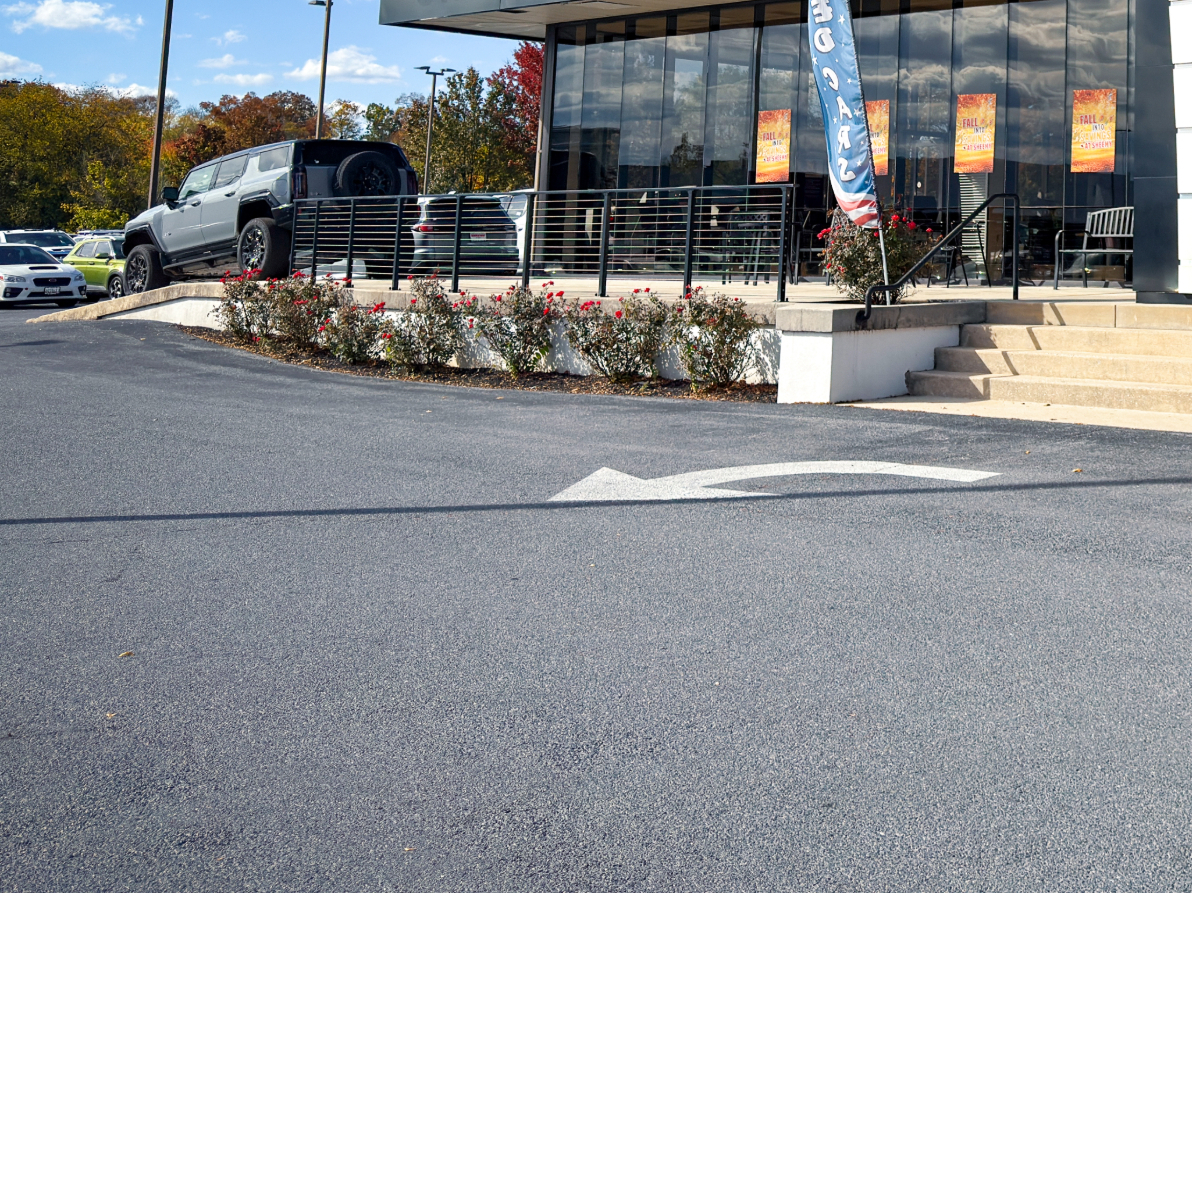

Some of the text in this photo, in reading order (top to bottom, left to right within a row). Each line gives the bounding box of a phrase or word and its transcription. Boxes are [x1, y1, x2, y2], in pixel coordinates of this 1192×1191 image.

[962, 117, 978, 128] FALL
[1080, 114, 1097, 125] FALL
[762, 131, 776, 141] FALL
